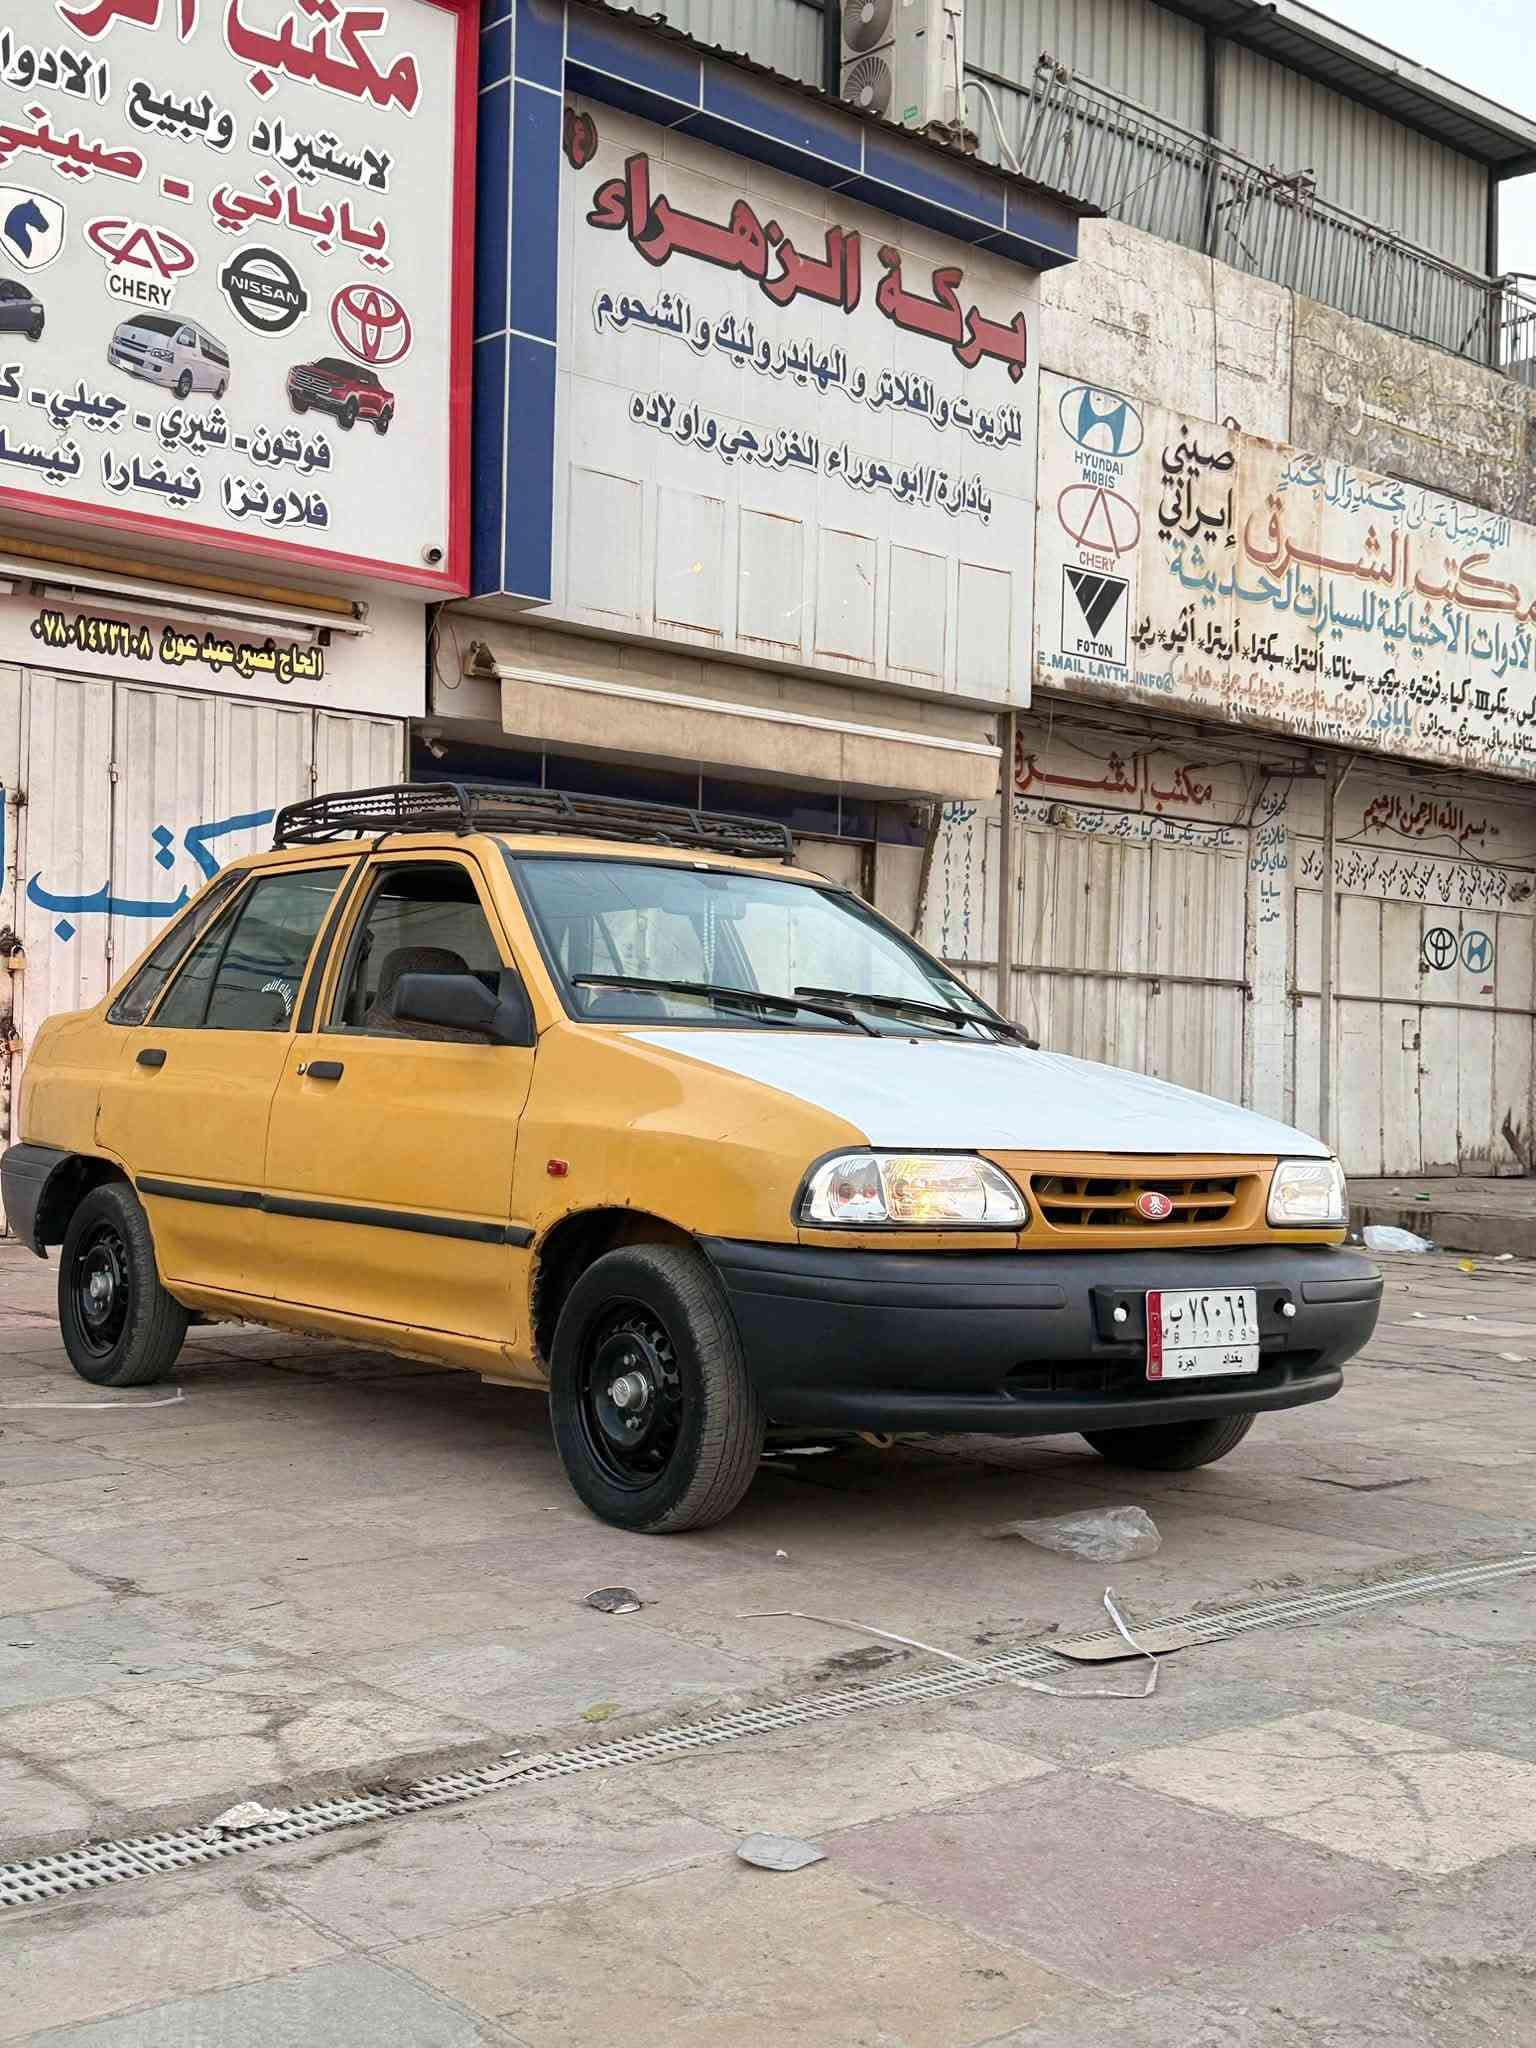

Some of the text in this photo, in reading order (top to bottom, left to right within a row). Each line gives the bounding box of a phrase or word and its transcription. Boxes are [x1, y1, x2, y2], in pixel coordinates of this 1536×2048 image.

[227, 0, 420, 111] مكتب
[0, 30, 391, 190] لاستيراد ولبيع الادوا
[212, 174, 390, 269] ياباني
[587, 153, 1027, 384] بركة الزهراء
[108, 273, 173, 307] CHERY
[229, 274, 301, 305] NISSAN
[160, 407, 228, 454] شيري
[720, 429, 820, 468] الخزرجي
[1074, 450, 1124, 477] HYUNDAI
[1161, 424, 1236, 484] صيني
[0, 429, 328, 527] فلاونزا نيفارا نيسا
[1082, 468, 1116, 489] MOBIS
[1244, 493, 1409, 578] الشرق
[1079, 550, 1116, 573] CHERY
[159, 625, 200, 665] عون
[200, 633, 236, 671] عبد
[276, 644, 325, 683] الحاج
[1076, 638, 1113, 658] FOTON
[27, 808, 276, 942] كتب
[1169, 1295, 1247, 1329] ب ٧٢٠٦٩
